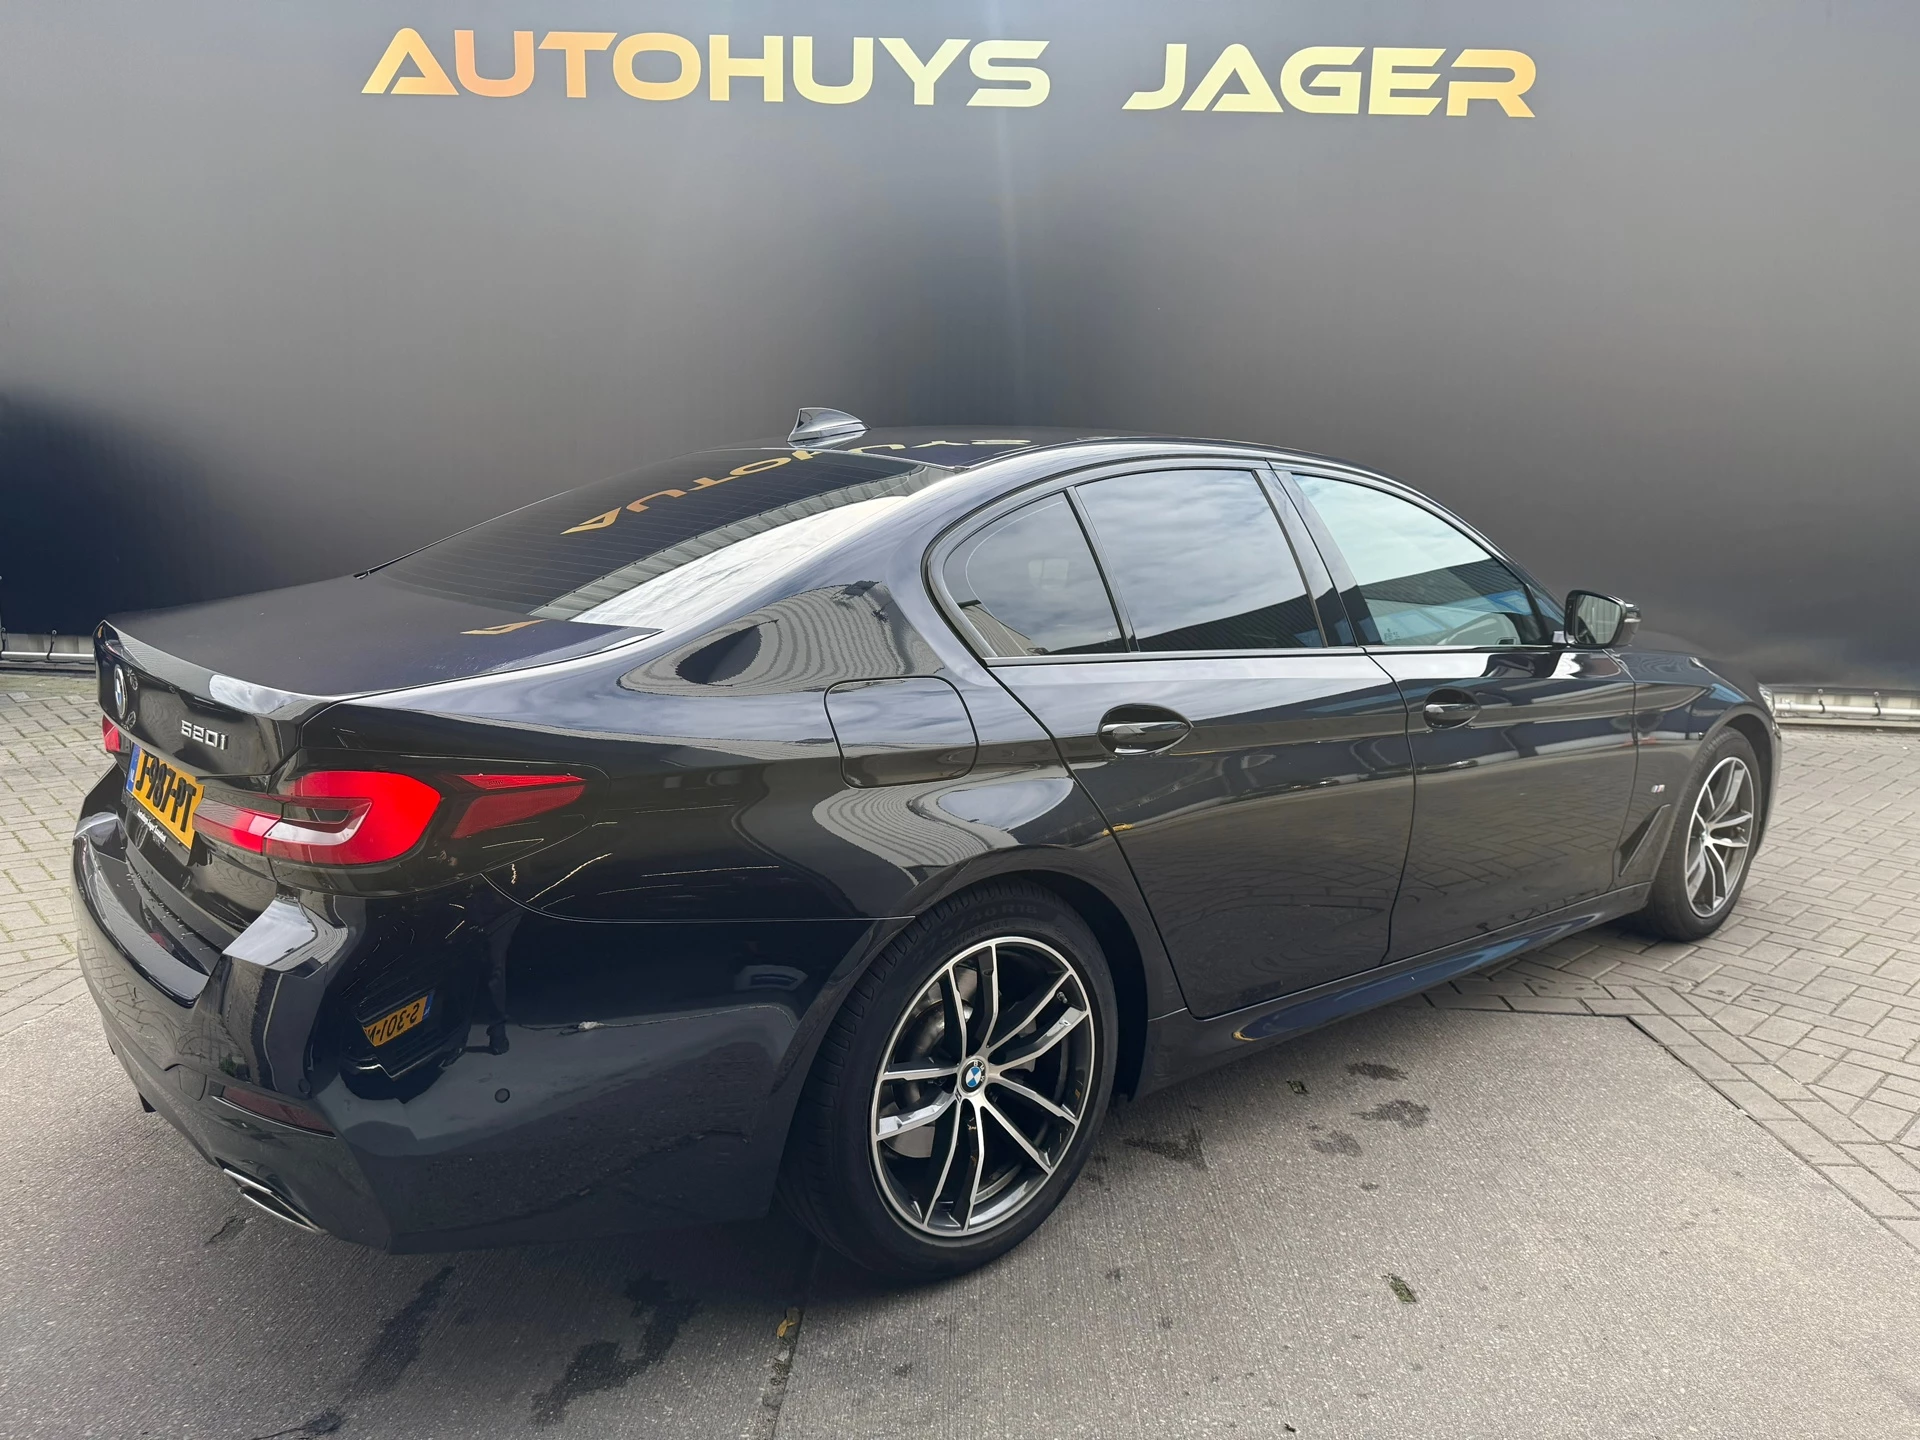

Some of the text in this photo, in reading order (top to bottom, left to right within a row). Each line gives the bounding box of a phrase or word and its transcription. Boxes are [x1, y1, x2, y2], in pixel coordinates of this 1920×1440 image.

[361, 27, 1536, 118] AUTOHUYS JAGER
[181, 719, 228, 750] 520i
[135, 754, 197, 833] J-987-PT
